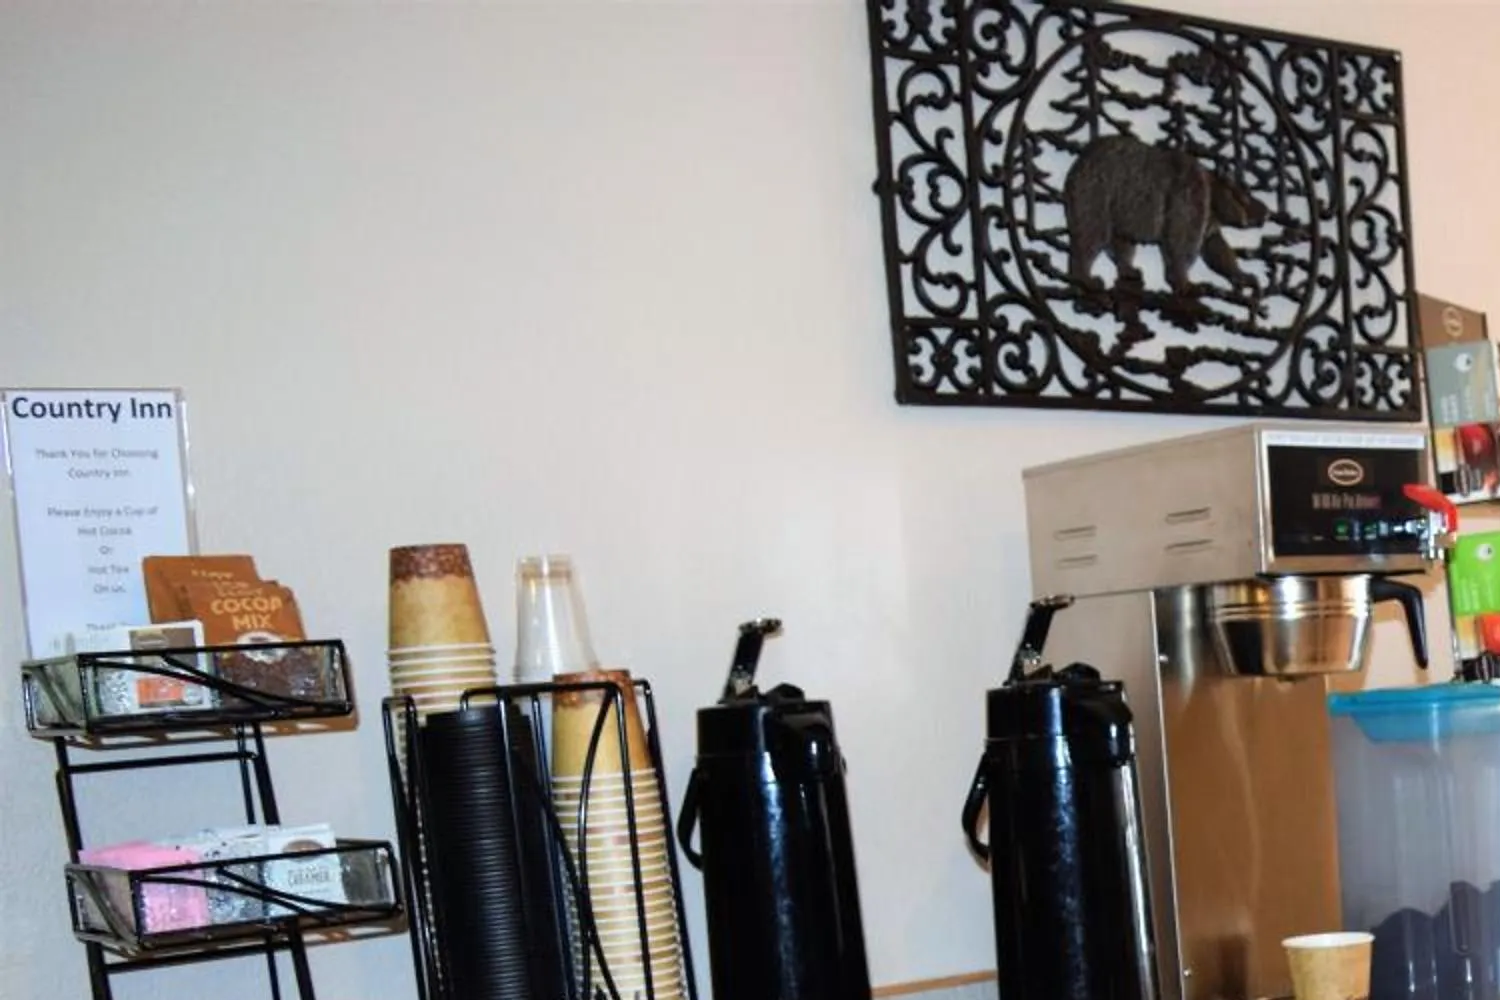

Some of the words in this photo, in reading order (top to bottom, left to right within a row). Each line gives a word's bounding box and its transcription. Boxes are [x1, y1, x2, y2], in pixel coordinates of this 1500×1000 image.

[12, 397, 121, 423] Country
[131, 398, 172, 418] Inn
[36, 448, 67, 459] Thank
[70, 449, 91, 459] You
[68, 467, 110, 478] Country
[47, 507, 80, 517] Please
[83, 507, 113, 518] Enjoy
[77, 527, 97, 536] Hot
[210, 596, 283, 615] COCOA
[231, 613, 275, 631] MIX
